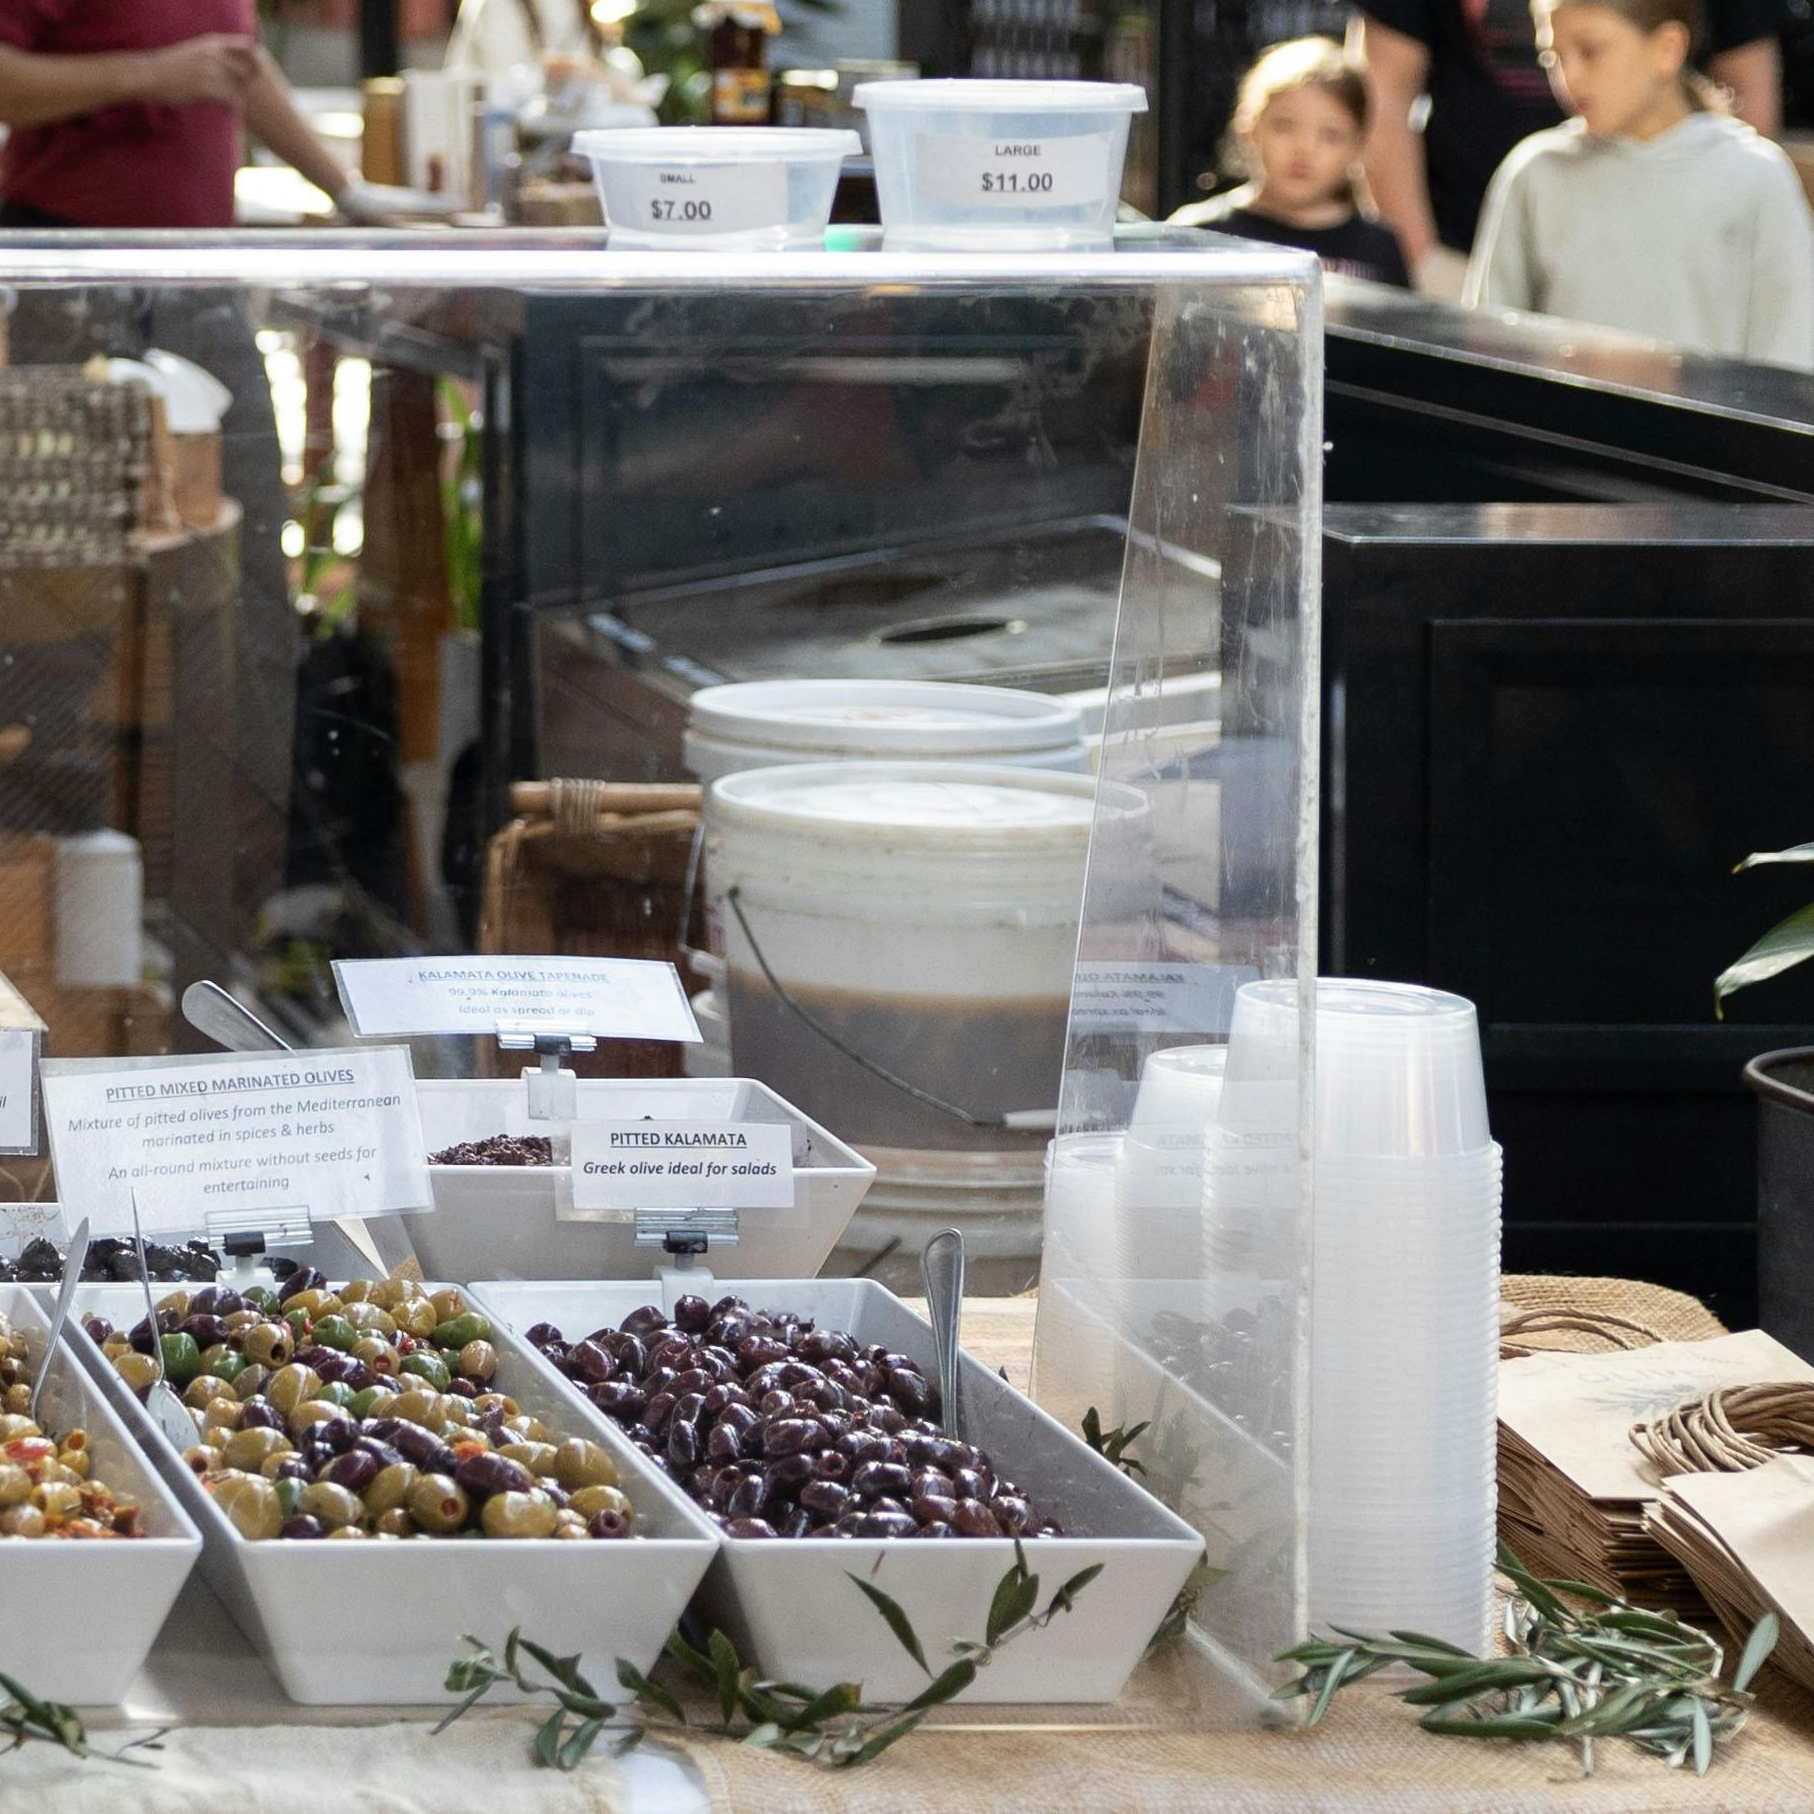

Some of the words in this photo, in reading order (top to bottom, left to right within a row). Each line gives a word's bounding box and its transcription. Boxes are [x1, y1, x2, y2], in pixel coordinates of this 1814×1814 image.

[994, 144, 1042, 157] LARGE
[659, 174, 696, 184] SMALL
[981, 171, 1054, 194] $11.00
[651, 199, 712, 222] $7.00
[418, 970, 494, 982] KALAMATA
[496, 970, 535, 982] OLIVE
[537, 971, 610, 984] TAPENADE
[106, 1085, 156, 1102] PITTED
[160, 1080, 208, 1097] MIXED
[212, 1074, 300, 1094] MARINATED
[304, 1069, 355, 1085] OLIVES
[68, 1115, 122, 1132] Mixture
[127, 1113, 141, 1130] of
[144, 1110, 185, 1129] pitted
[189, 1107, 229, 1122] olives
[231, 1103, 267, 1121] from
[270, 1101, 293, 1115] the
[297, 1093, 401, 1113] Mediterranean
[142, 1130, 215, 1149] marinated
[218, 1128, 231, 1141] in
[235, 1125, 277, 1142] spices
[281, 1123, 292, 1137] &
[296, 1120, 335, 1136] herbs
[610, 1132, 660, 1148] PITTED
[664, 1132, 748, 1149] KALAMATA
[108, 1166, 128, 1180] An
[131, 1160, 195, 1178] all-round
[198, 1156, 253, 1172] mixture
[256, 1152, 310, 1168] without
[314, 1147, 353, 1163] seeds
[355, 1145, 377, 1163] for
[583, 1161, 626, 1175] Greek
[630, 1161, 664, 1175] olive
[668, 1161, 703, 1175] ideal
[705, 1161, 728, 1178] for
[731, 1162, 777, 1176] salads
[203, 1176, 290, 1195] entertaining
